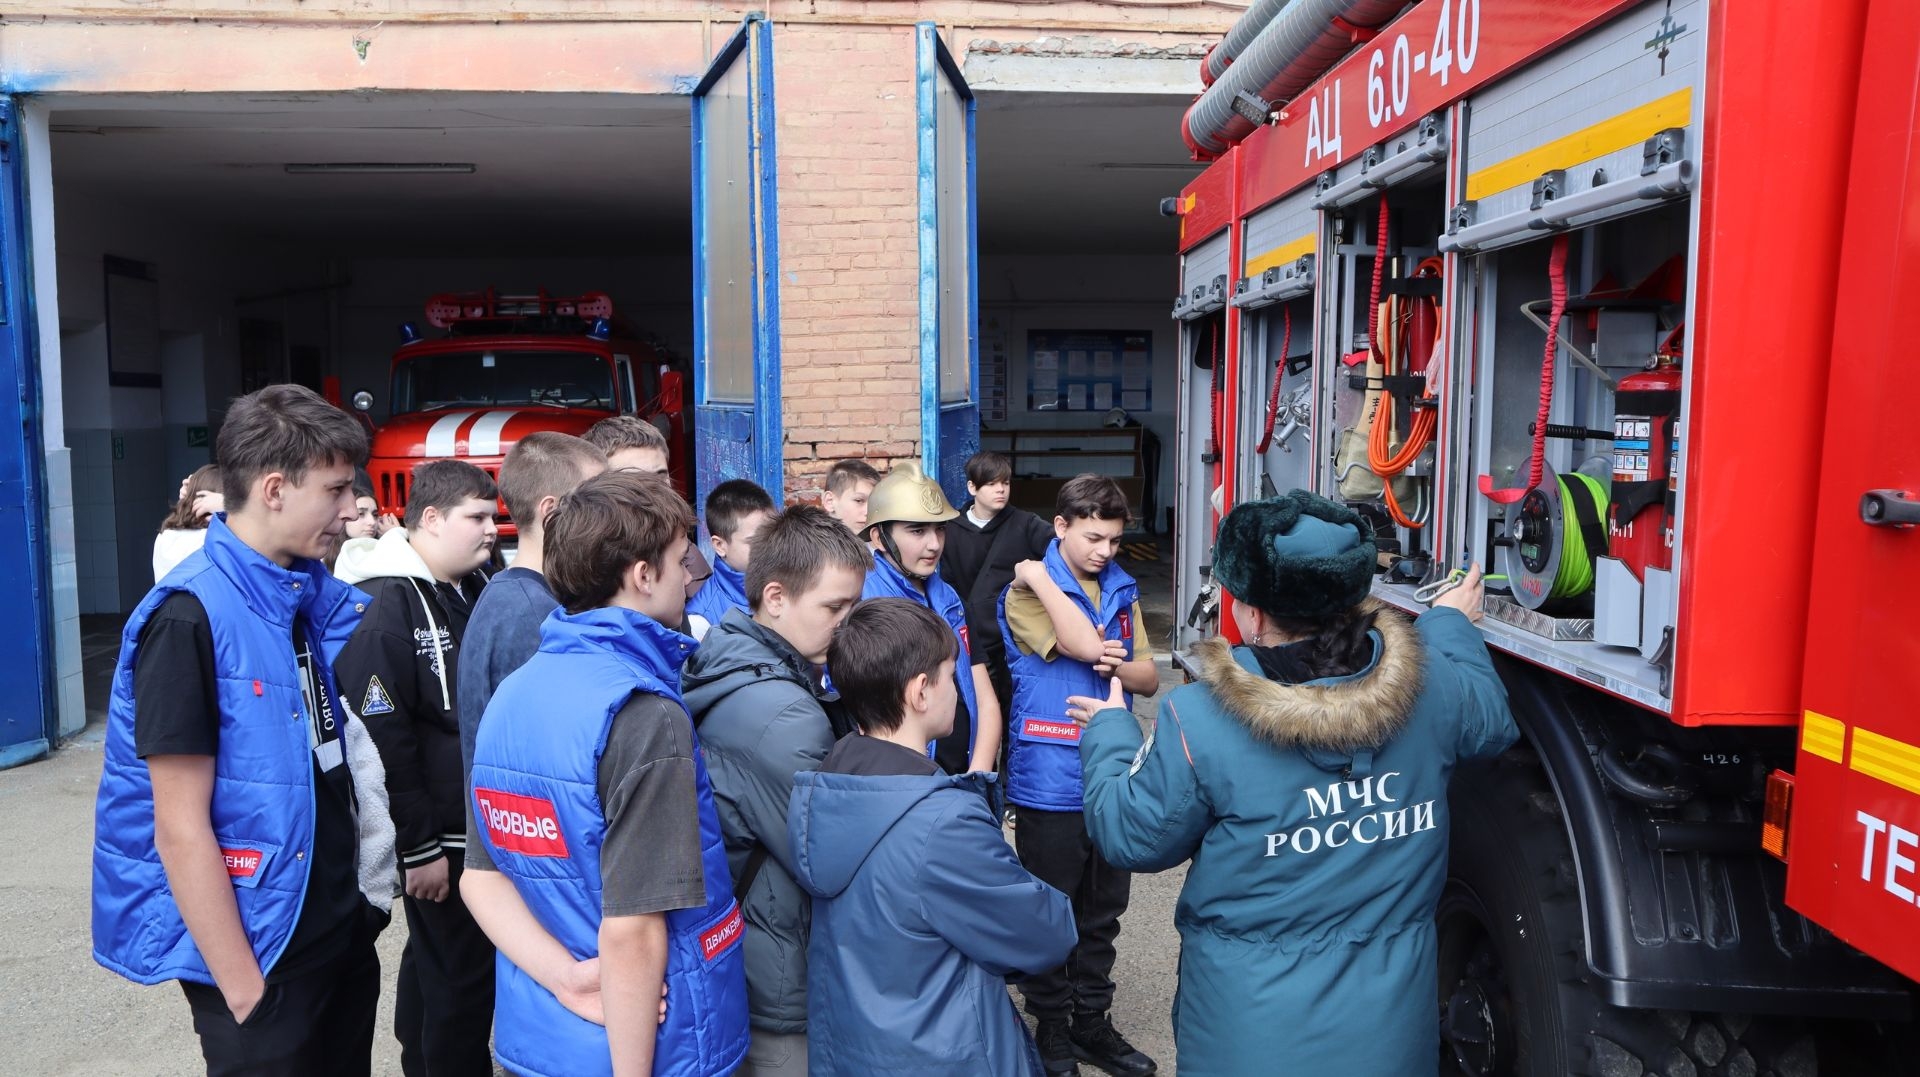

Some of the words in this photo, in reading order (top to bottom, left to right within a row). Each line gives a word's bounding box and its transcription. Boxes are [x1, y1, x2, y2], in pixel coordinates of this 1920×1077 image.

[1305, 78, 1342, 168] АЦ
[1367, 0, 1480, 128] 6.0-40
[1027, 723, 1077, 736] ДВИЖЕНИЕ
[480, 798, 558, 841] Первые
[1303, 772, 1401, 820] МЧС
[1264, 799, 1437, 858] РОССИИ
[222, 855, 258, 869] ЕНИЕ
[1856, 809, 1920, 909] ТЕ
